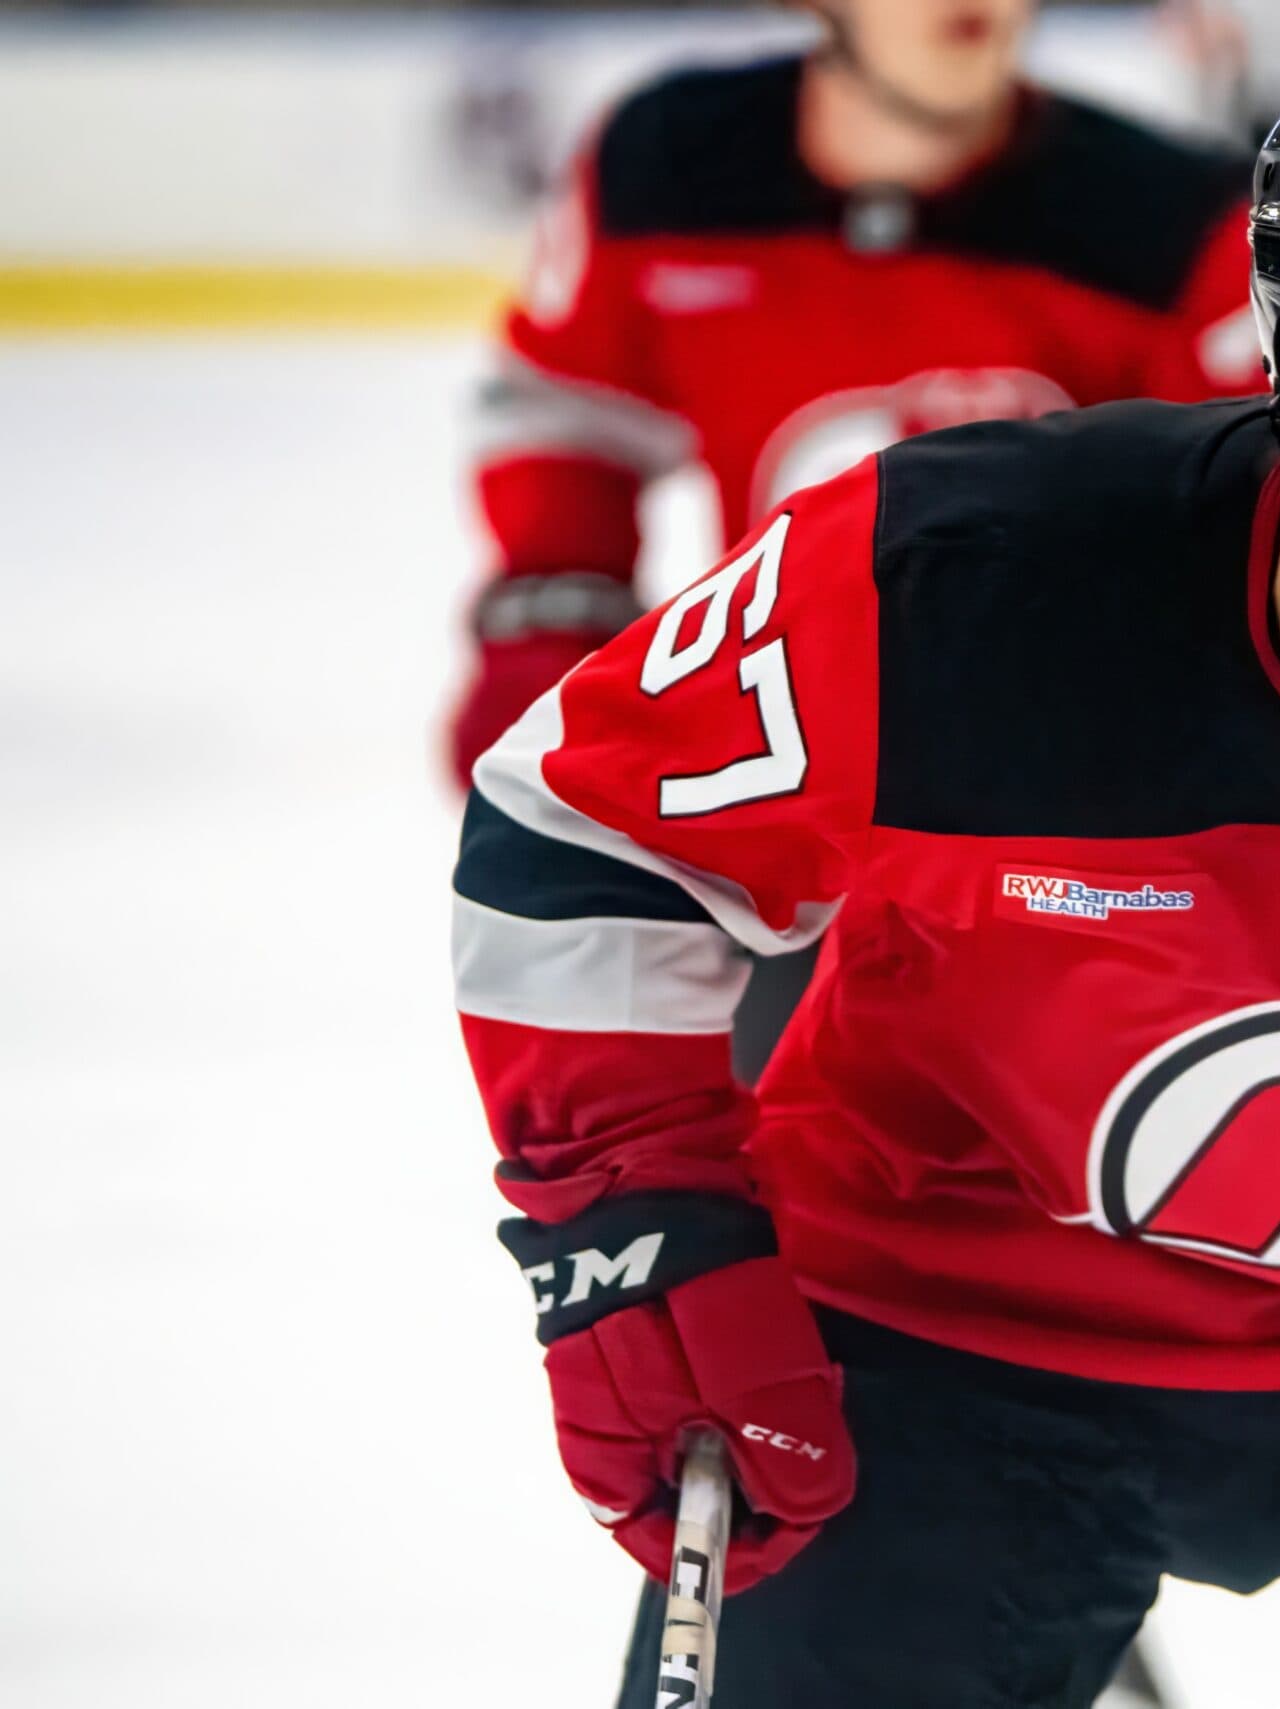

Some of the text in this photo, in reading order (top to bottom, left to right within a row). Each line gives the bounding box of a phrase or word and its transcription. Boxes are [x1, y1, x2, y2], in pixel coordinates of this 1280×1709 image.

[640, 511, 808, 818] 67
[1029, 897, 1107, 918] HEALTH
[741, 1423, 827, 1461] CCM
